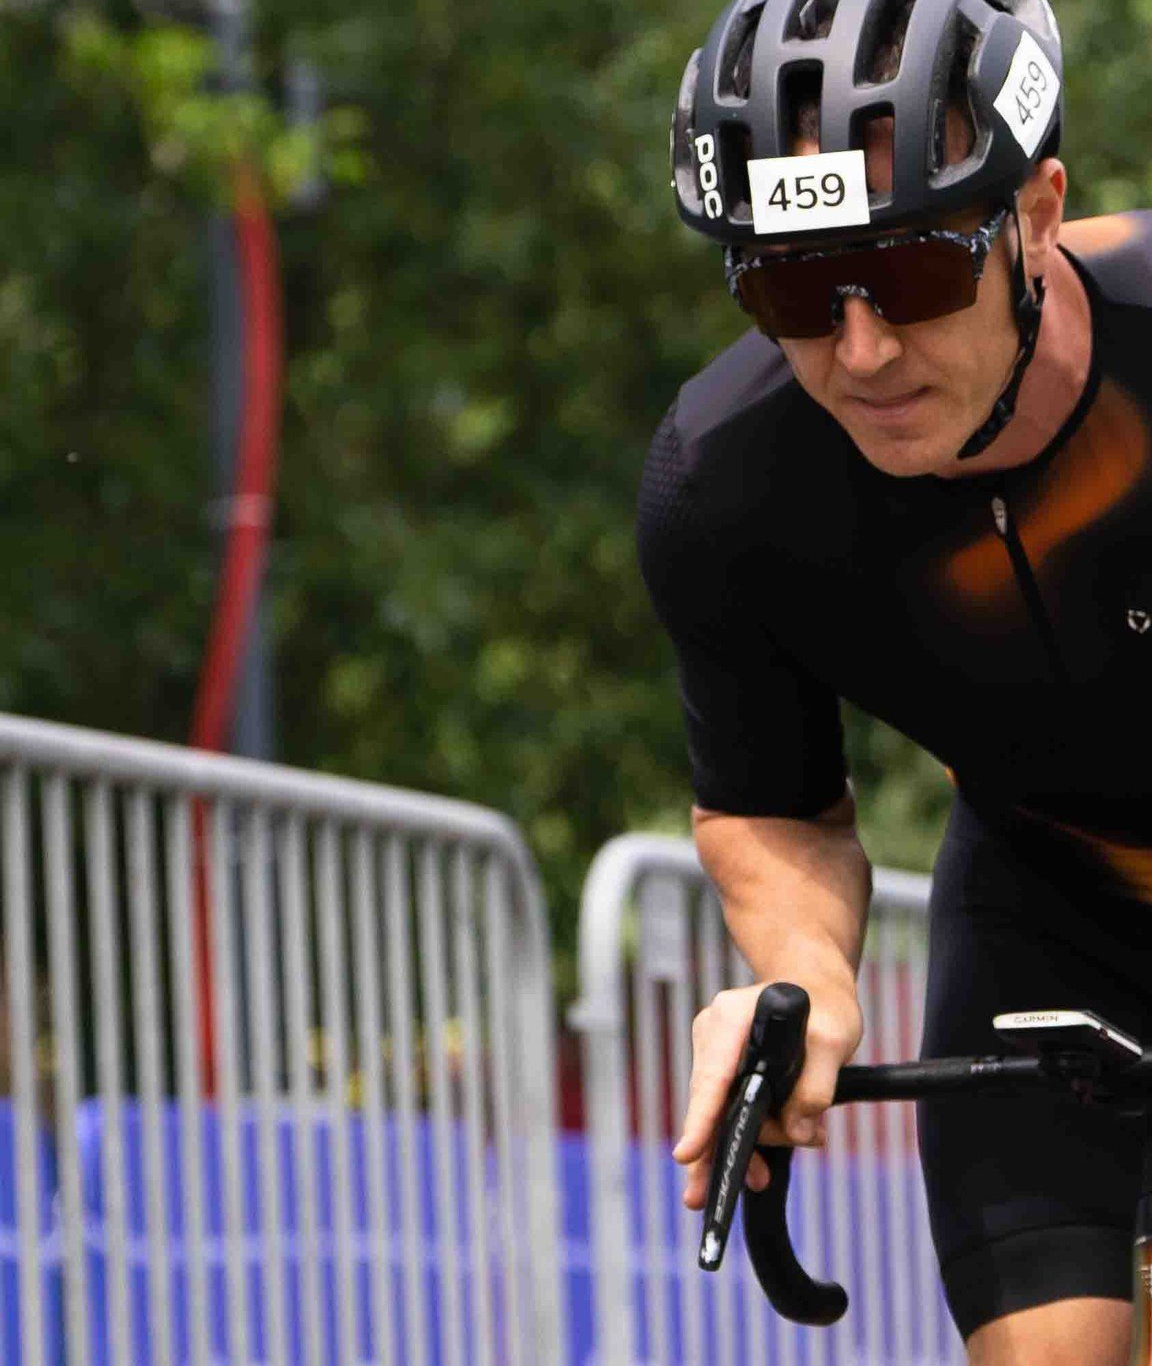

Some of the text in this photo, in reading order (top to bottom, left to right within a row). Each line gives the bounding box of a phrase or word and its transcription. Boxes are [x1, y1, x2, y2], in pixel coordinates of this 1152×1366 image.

[1015, 60, 1047, 126] 459
[694, 134, 723, 219] POC
[768, 173, 845, 211] 459
